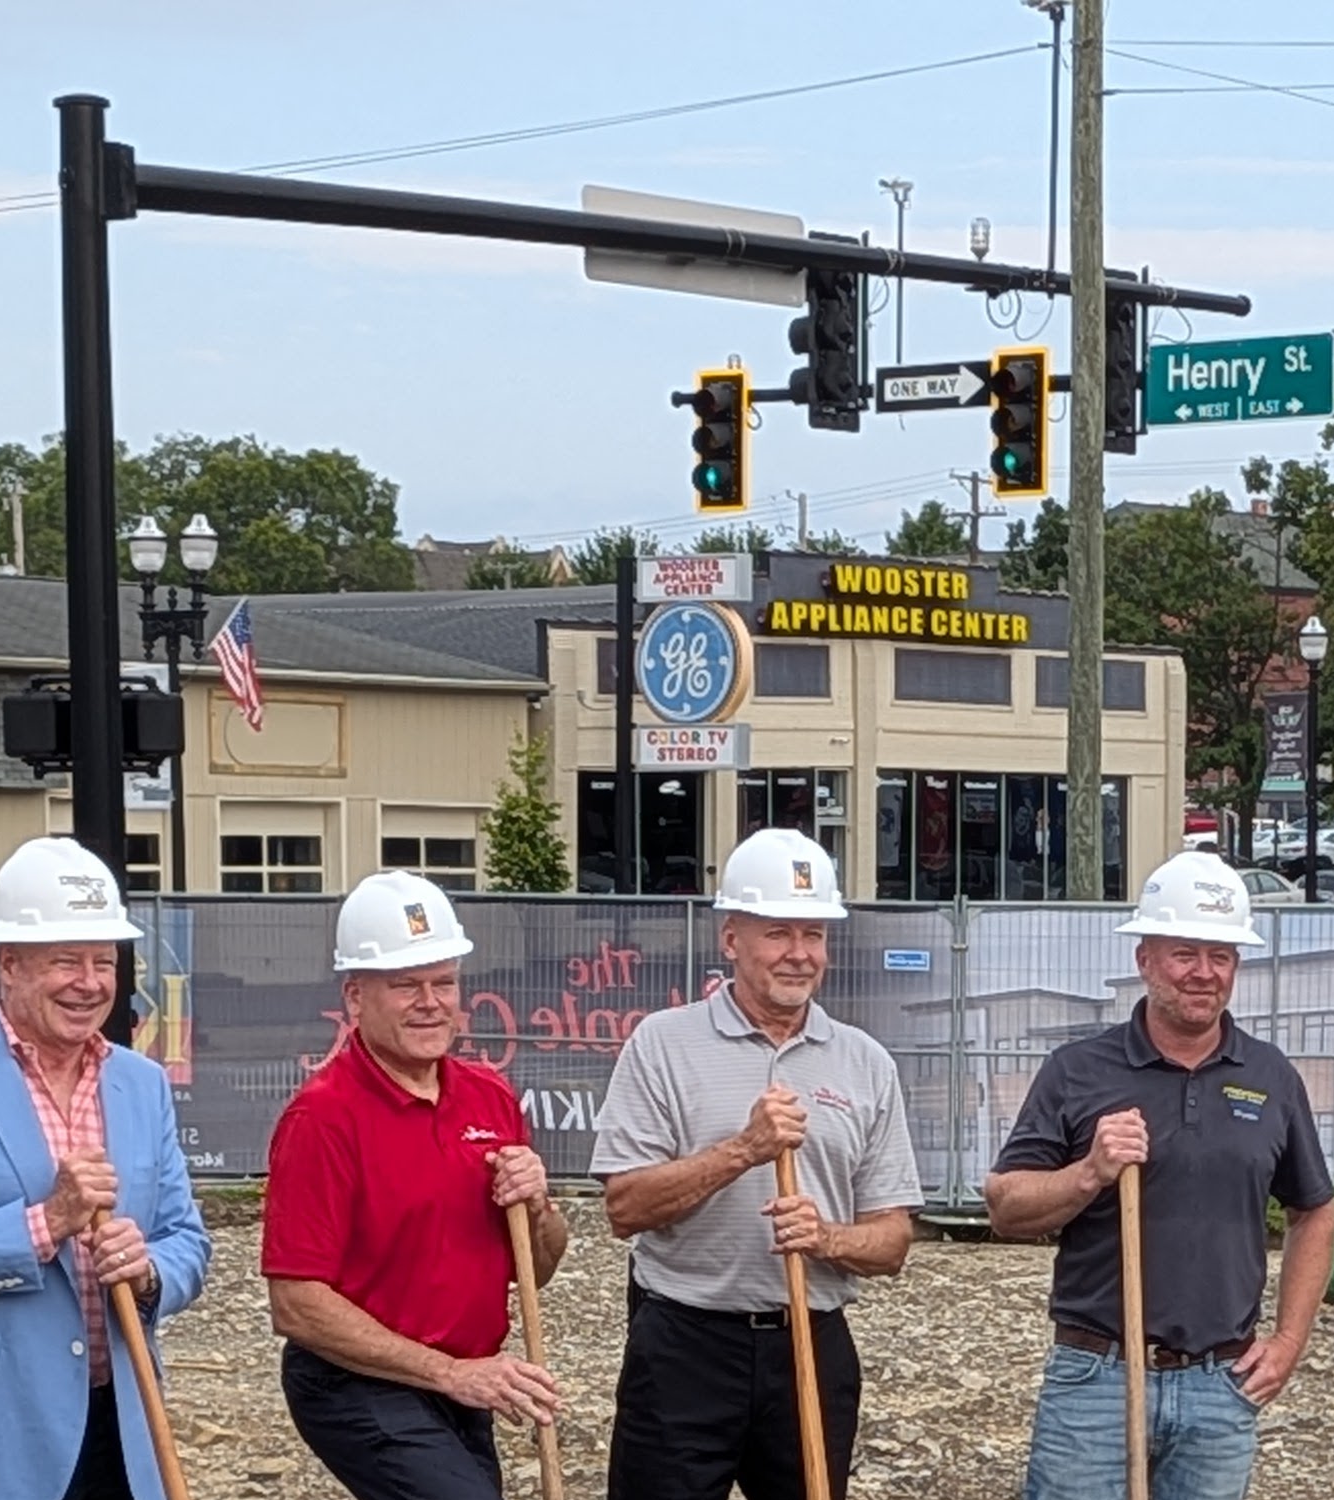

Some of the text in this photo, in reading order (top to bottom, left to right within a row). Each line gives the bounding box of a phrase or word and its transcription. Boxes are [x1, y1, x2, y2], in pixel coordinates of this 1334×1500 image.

[1168, 345, 1313, 395] Henry St.
[890, 377, 958, 397] ONE WAY
[1198, 403, 1229, 418] WEST
[1249, 399, 1280, 415] EAST
[658, 559, 720, 572] WOOSTER
[653, 572, 723, 585] APPLIANCE
[835, 565, 969, 599] WOOSTER
[664, 584, 713, 596] CENTER
[771, 602, 1029, 642] APPLIANCE CENTER
[660, 632, 712, 698] GE
[647, 731, 727, 745] COLOR TV
[657, 747, 717, 762] STEREO
